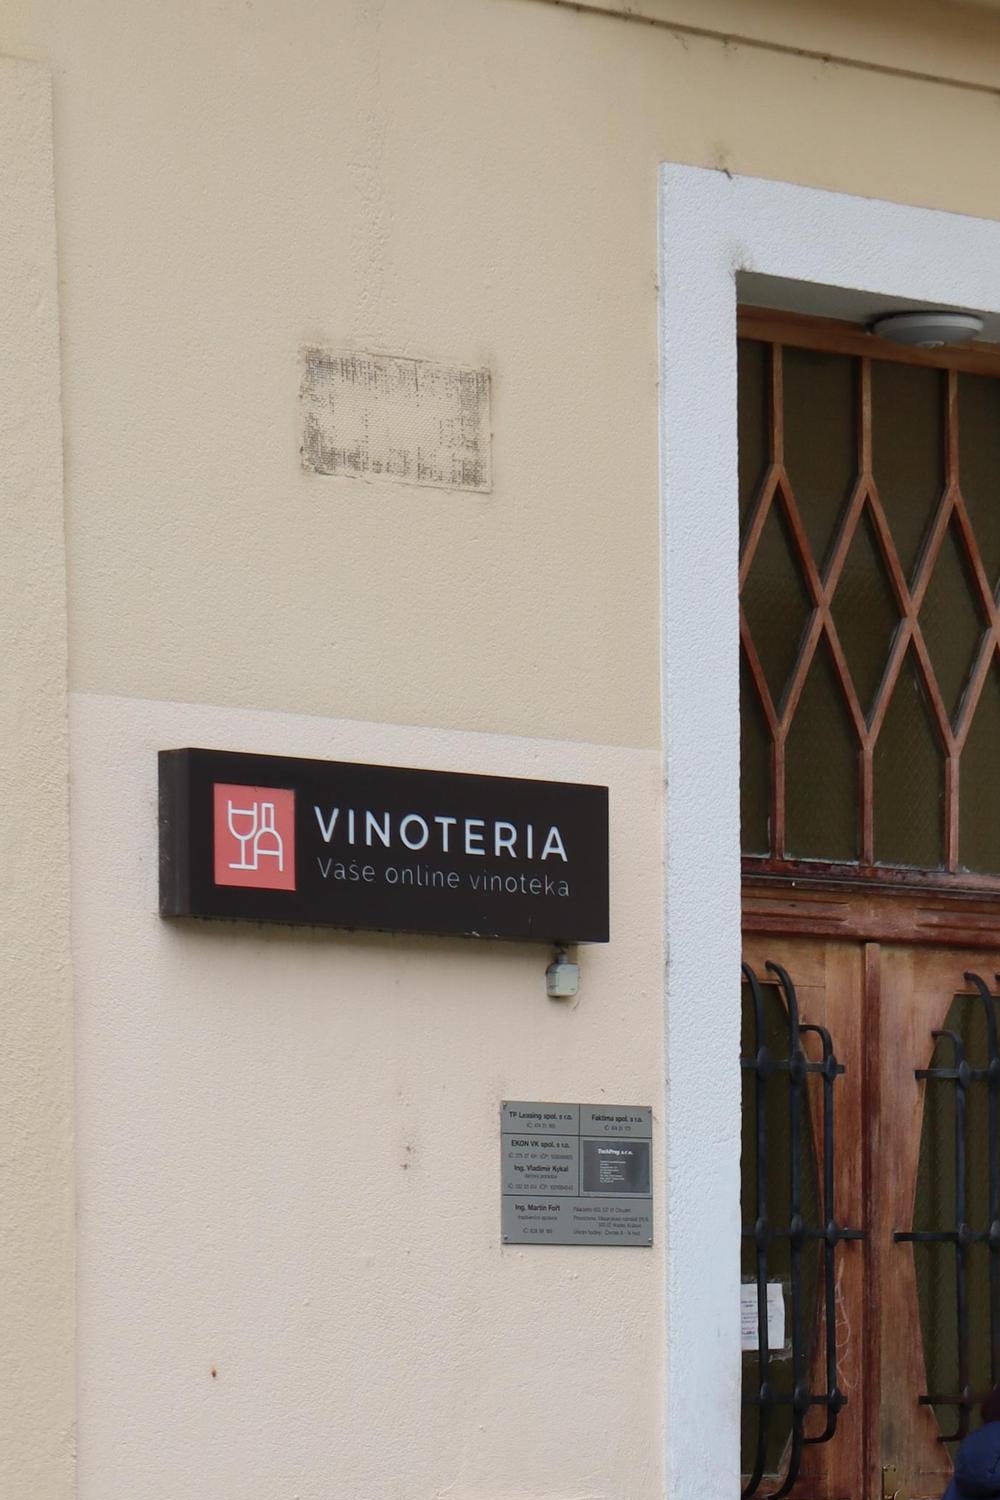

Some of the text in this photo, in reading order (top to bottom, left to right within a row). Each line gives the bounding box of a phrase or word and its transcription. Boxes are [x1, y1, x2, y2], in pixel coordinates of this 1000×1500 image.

[313, 805, 569, 862] VINOTERIA
[317, 856, 570, 898] Vaše online vinoteka
[511, 1139, 529, 1147] EKON
